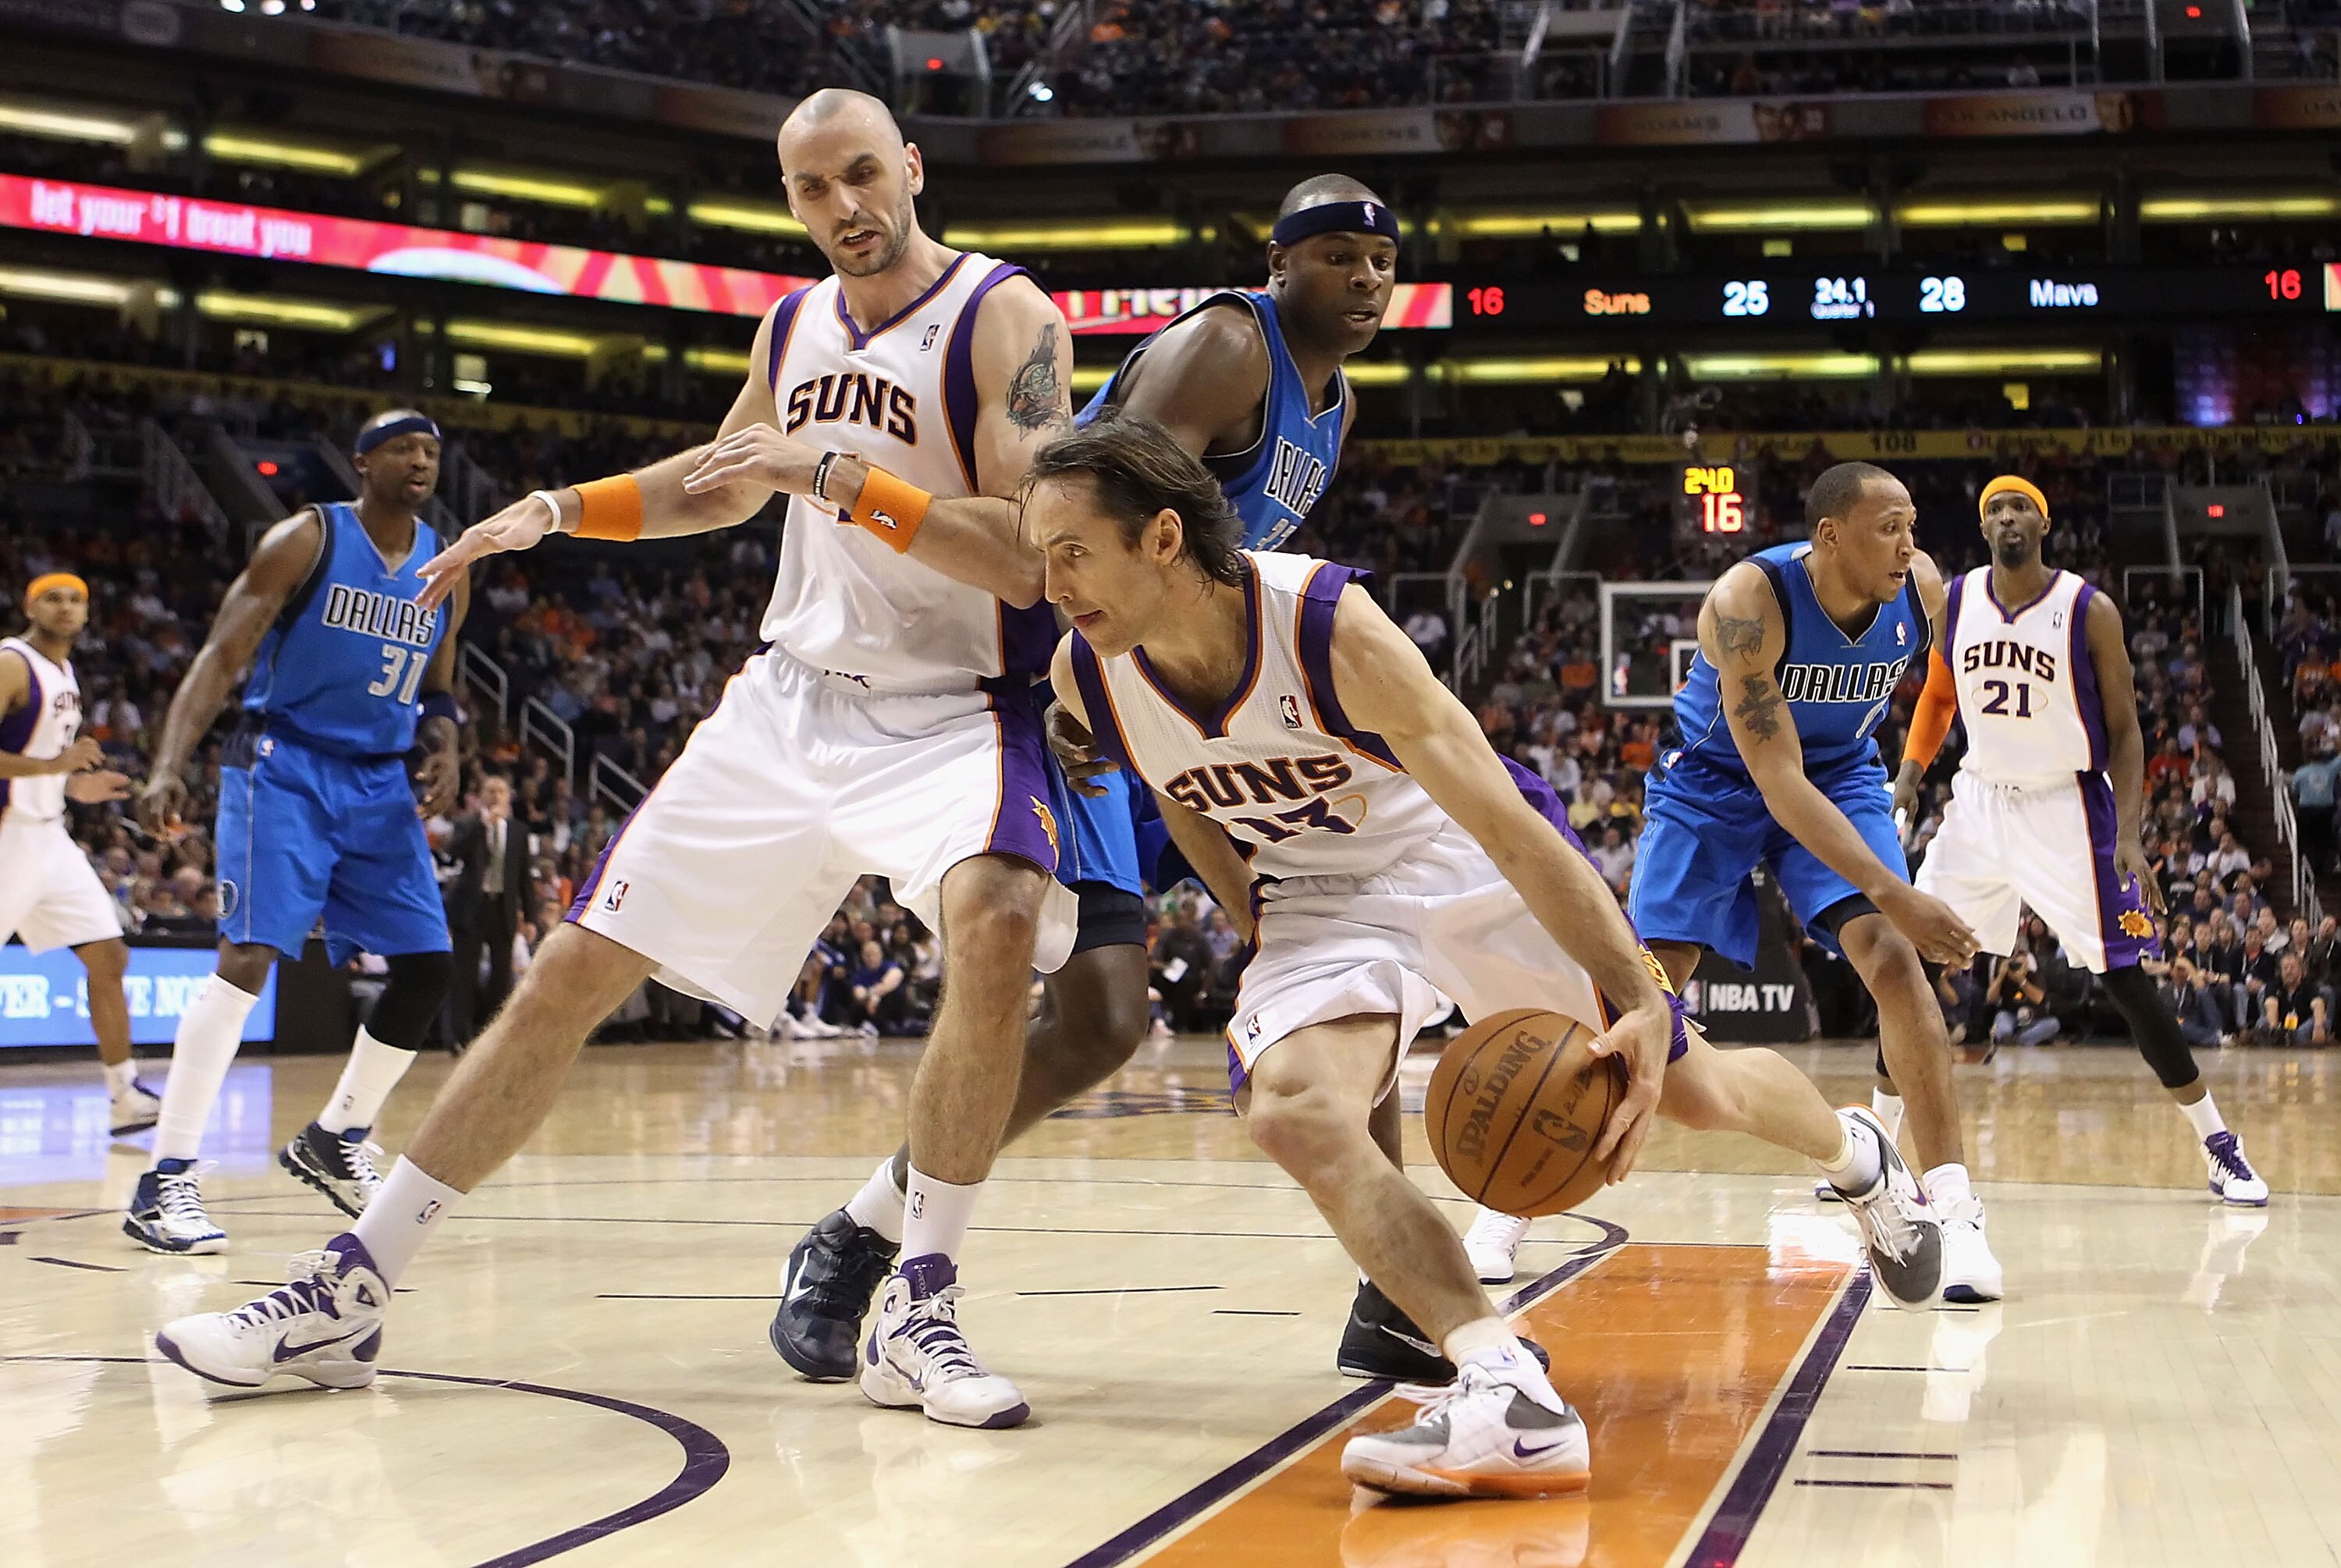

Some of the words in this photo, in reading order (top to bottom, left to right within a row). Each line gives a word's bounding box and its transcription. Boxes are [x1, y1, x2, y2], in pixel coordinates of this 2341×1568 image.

[79, 194, 147, 236] your
[187, 202, 255, 249] treat
[260, 218, 311, 258] you
[1468, 287, 1504, 315] 16
[1584, 289, 1650, 315] Suns
[1723, 281, 1769, 316] 25
[1815, 277, 1867, 304] 24.1
[1920, 276, 1966, 312] 28
[2030, 279, 2098, 307] Mavs
[2265, 270, 2301, 300] 16
[785, 374, 918, 448] SUNS
[1871, 433, 1917, 454] 108
[1263, 435, 1327, 520] DALLAS
[1701, 492, 1743, 533] 16
[322, 583, 438, 647] DALLAS
[368, 643, 428, 706] 31
[1781, 655, 1909, 703] DALLAS
[1963, 640, 2057, 683] SUNS
[1980, 679, 2033, 719] 21
[1165, 754, 1355, 814] SUNS
[1708, 983, 1760, 1013] NBA
[1760, 983, 1795, 1013] TV
